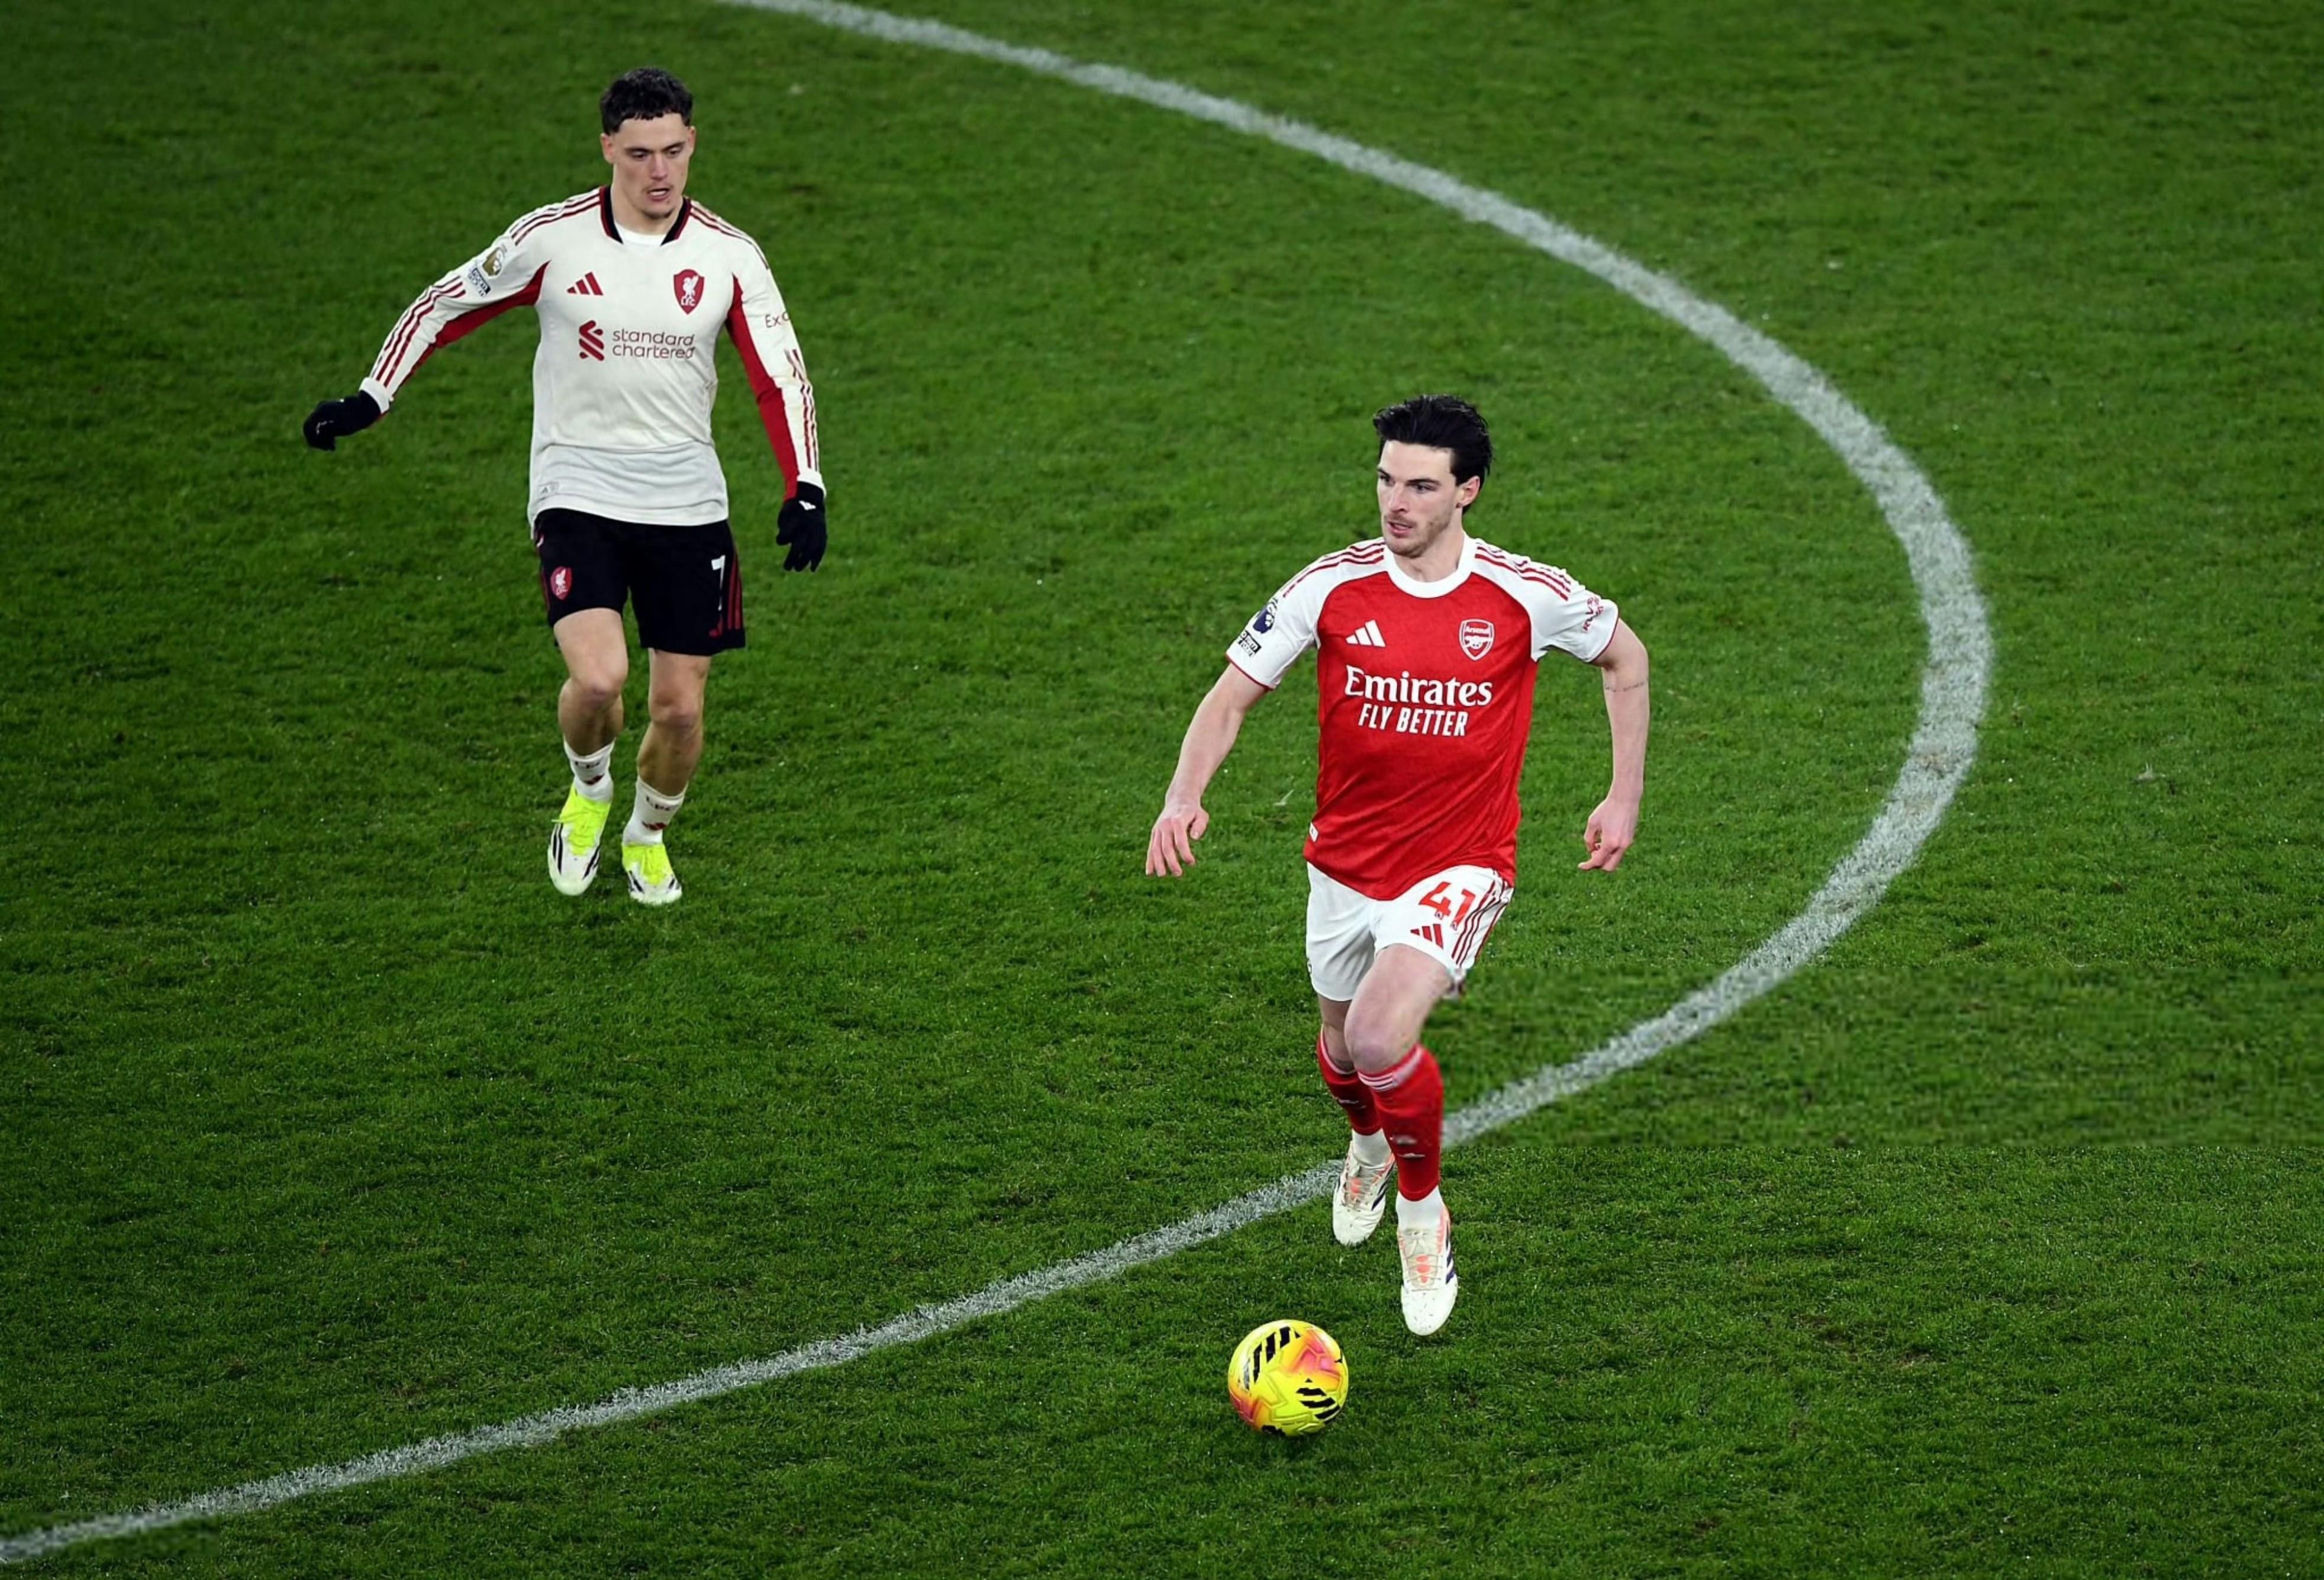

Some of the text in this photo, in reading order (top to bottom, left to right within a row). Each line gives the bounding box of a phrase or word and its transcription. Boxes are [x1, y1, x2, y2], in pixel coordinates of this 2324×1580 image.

[613, 328, 695, 346] standard
[613, 343, 696, 359] chartered
[1345, 664, 1493, 707] Emirates
[1358, 703, 1469, 736] FLY BETTER
[1419, 881, 1476, 931] 41
